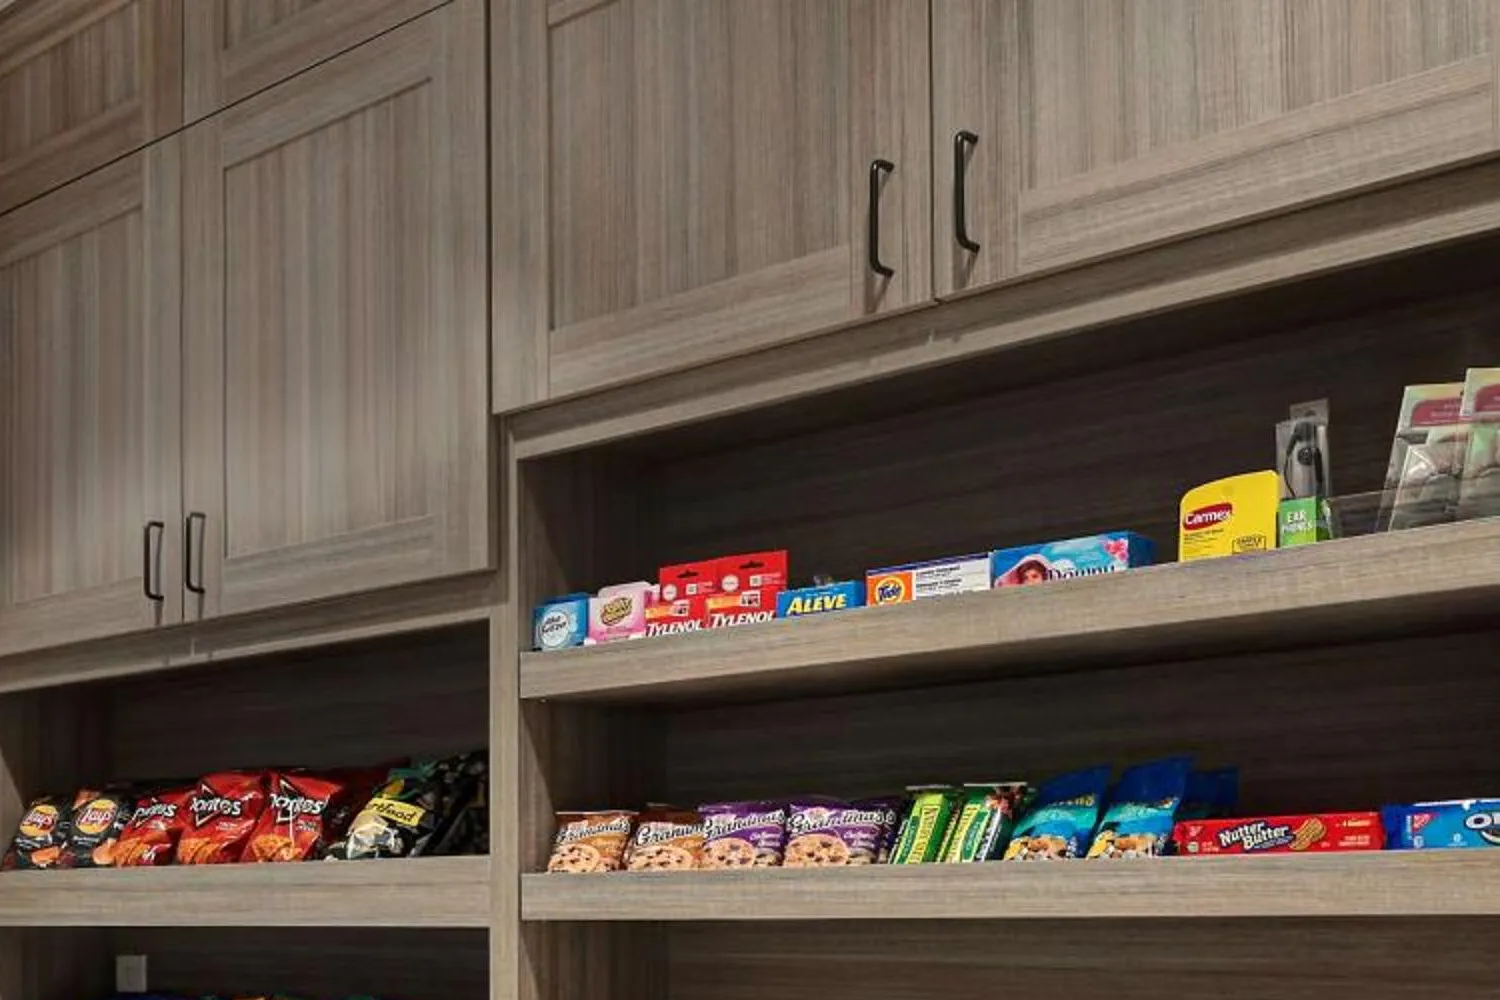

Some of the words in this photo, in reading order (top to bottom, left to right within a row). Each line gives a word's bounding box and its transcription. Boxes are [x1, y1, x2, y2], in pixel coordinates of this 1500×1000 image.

[1185, 510, 1231, 525] Carmex
[786, 594, 847, 616] ALEVE
[647, 618, 704, 637] TYLENOL
[708, 611, 776, 629] TYLENOL
[1218, 821, 1265, 846] Nutter
[1242, 826, 1290, 849] Butter
